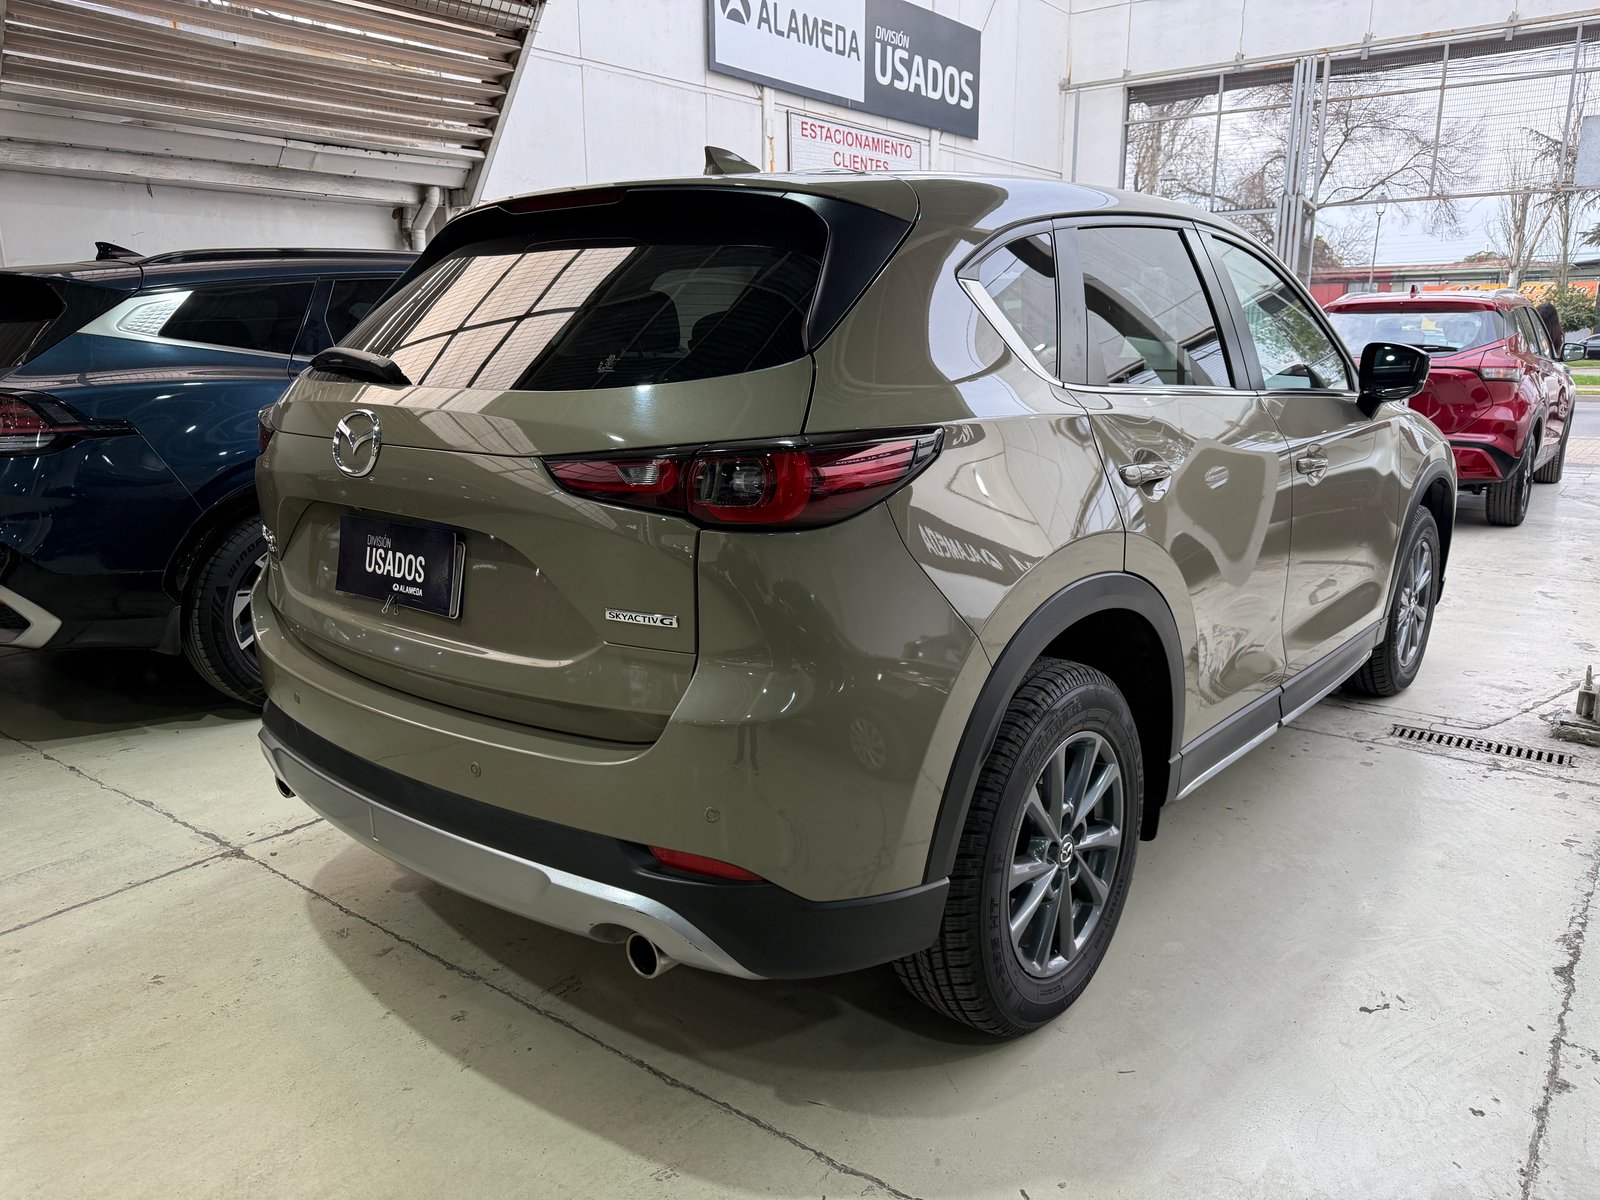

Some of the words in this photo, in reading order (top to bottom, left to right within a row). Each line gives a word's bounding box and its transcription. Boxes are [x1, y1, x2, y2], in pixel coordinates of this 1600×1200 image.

[757, 0, 861, 61] ALAMEDA
[875, 25, 909, 48] DIVISIÓN
[874, 42, 974, 110] USADOS
[801, 120, 913, 159] ESTACIONAMIENTO
[833, 151, 889, 171] CLIENTES
[367, 534, 392, 549] DIVISIÓN
[365, 546, 426, 583] USADOS
[399, 586, 423, 597] ALAMEDA
